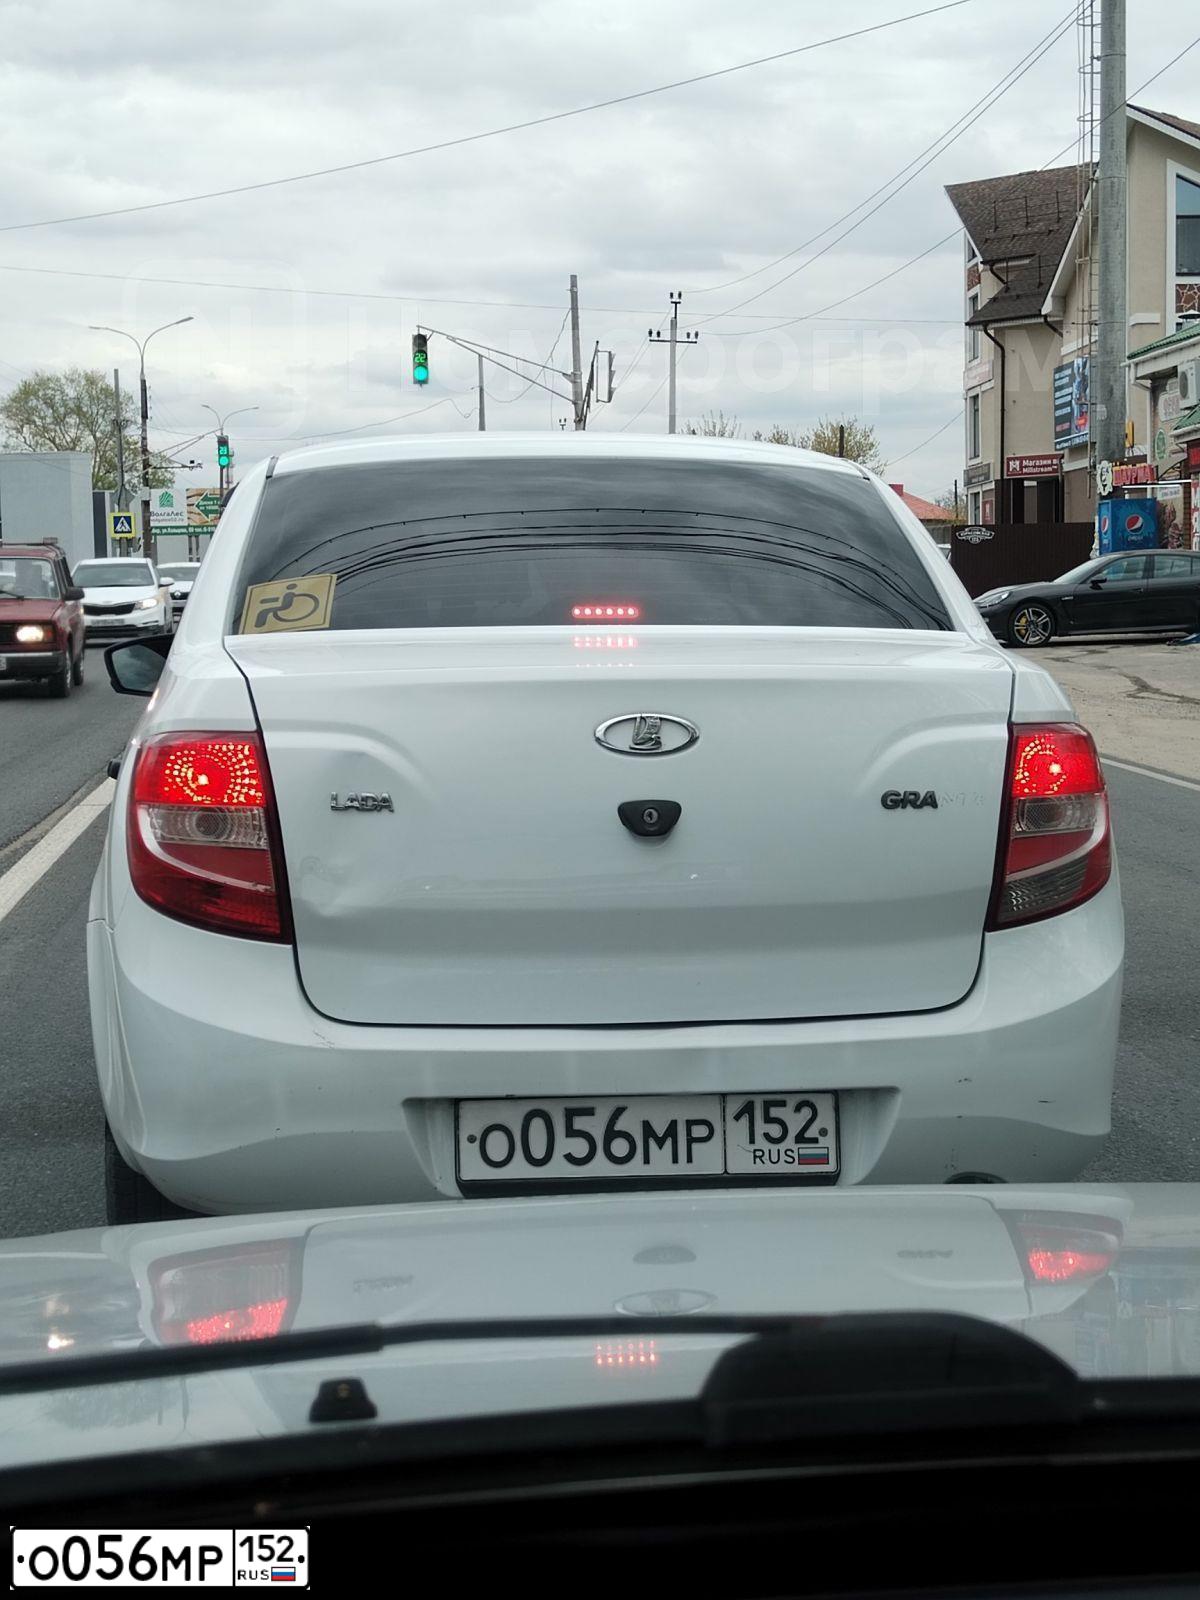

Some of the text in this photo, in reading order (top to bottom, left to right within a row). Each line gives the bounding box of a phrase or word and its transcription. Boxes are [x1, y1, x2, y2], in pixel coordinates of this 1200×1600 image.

[1022, 459, 1052, 467] Магазин
[330, 791, 394, 813] LADA
[732, 1099, 820, 1145] 152
[752, 1148, 796, 1165] RUS
